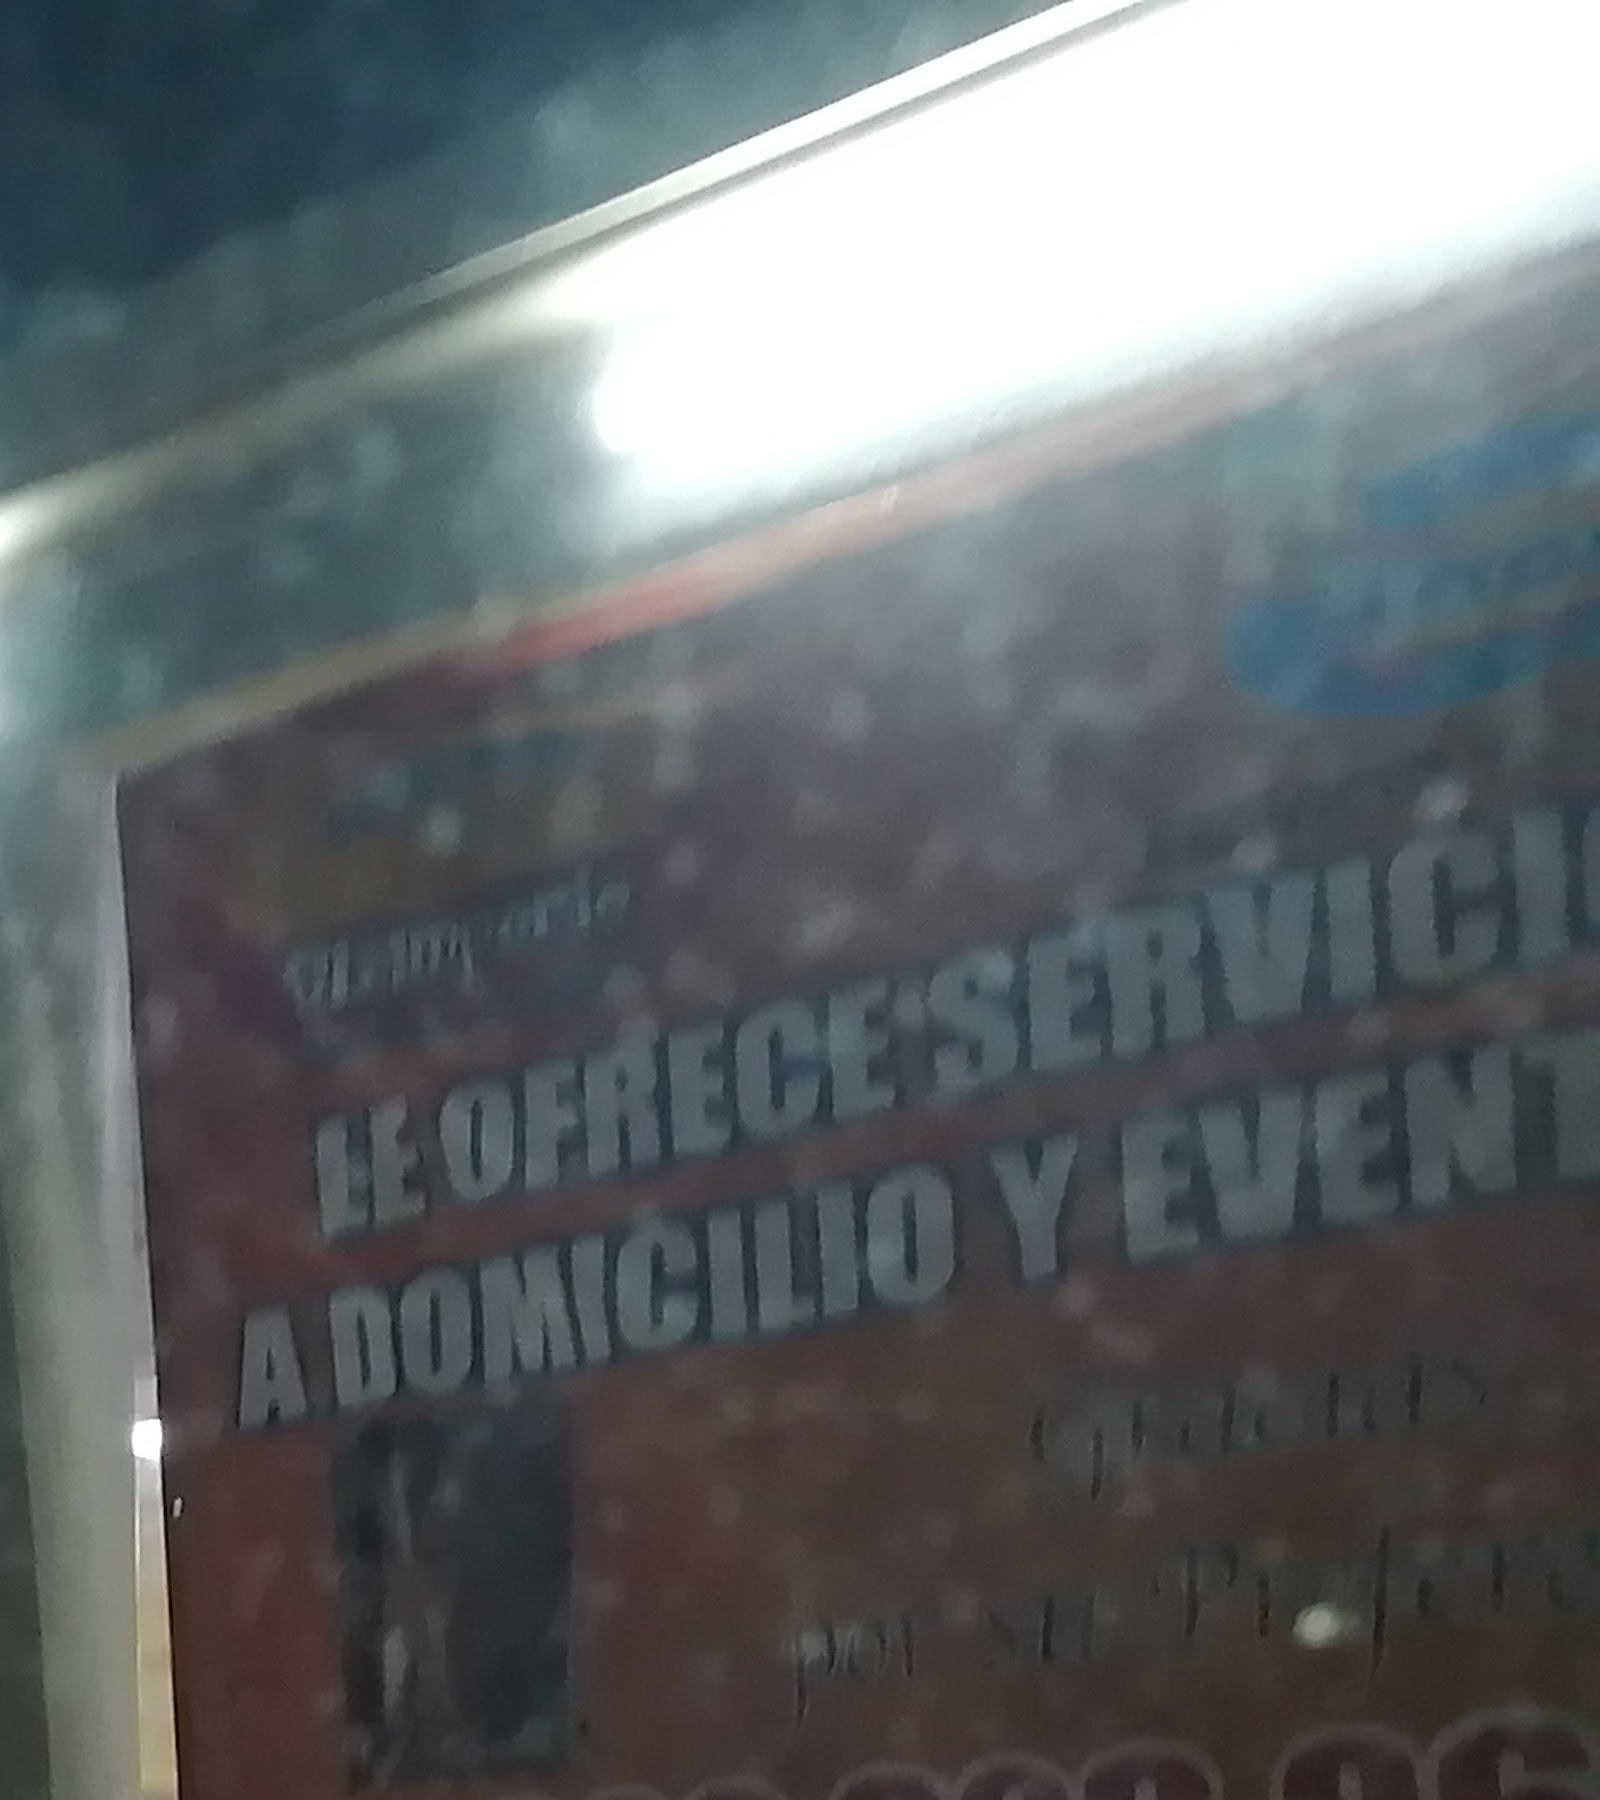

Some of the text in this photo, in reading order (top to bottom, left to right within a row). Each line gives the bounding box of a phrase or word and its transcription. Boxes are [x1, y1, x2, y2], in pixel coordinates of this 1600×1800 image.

[314, 805, 1600, 1236] LE OFRECE SERVICI
[239, 1303, 307, 1432] A
[329, 1165, 956, 1412] DOMICILIO
[990, 1133, 1078, 1280] Y
